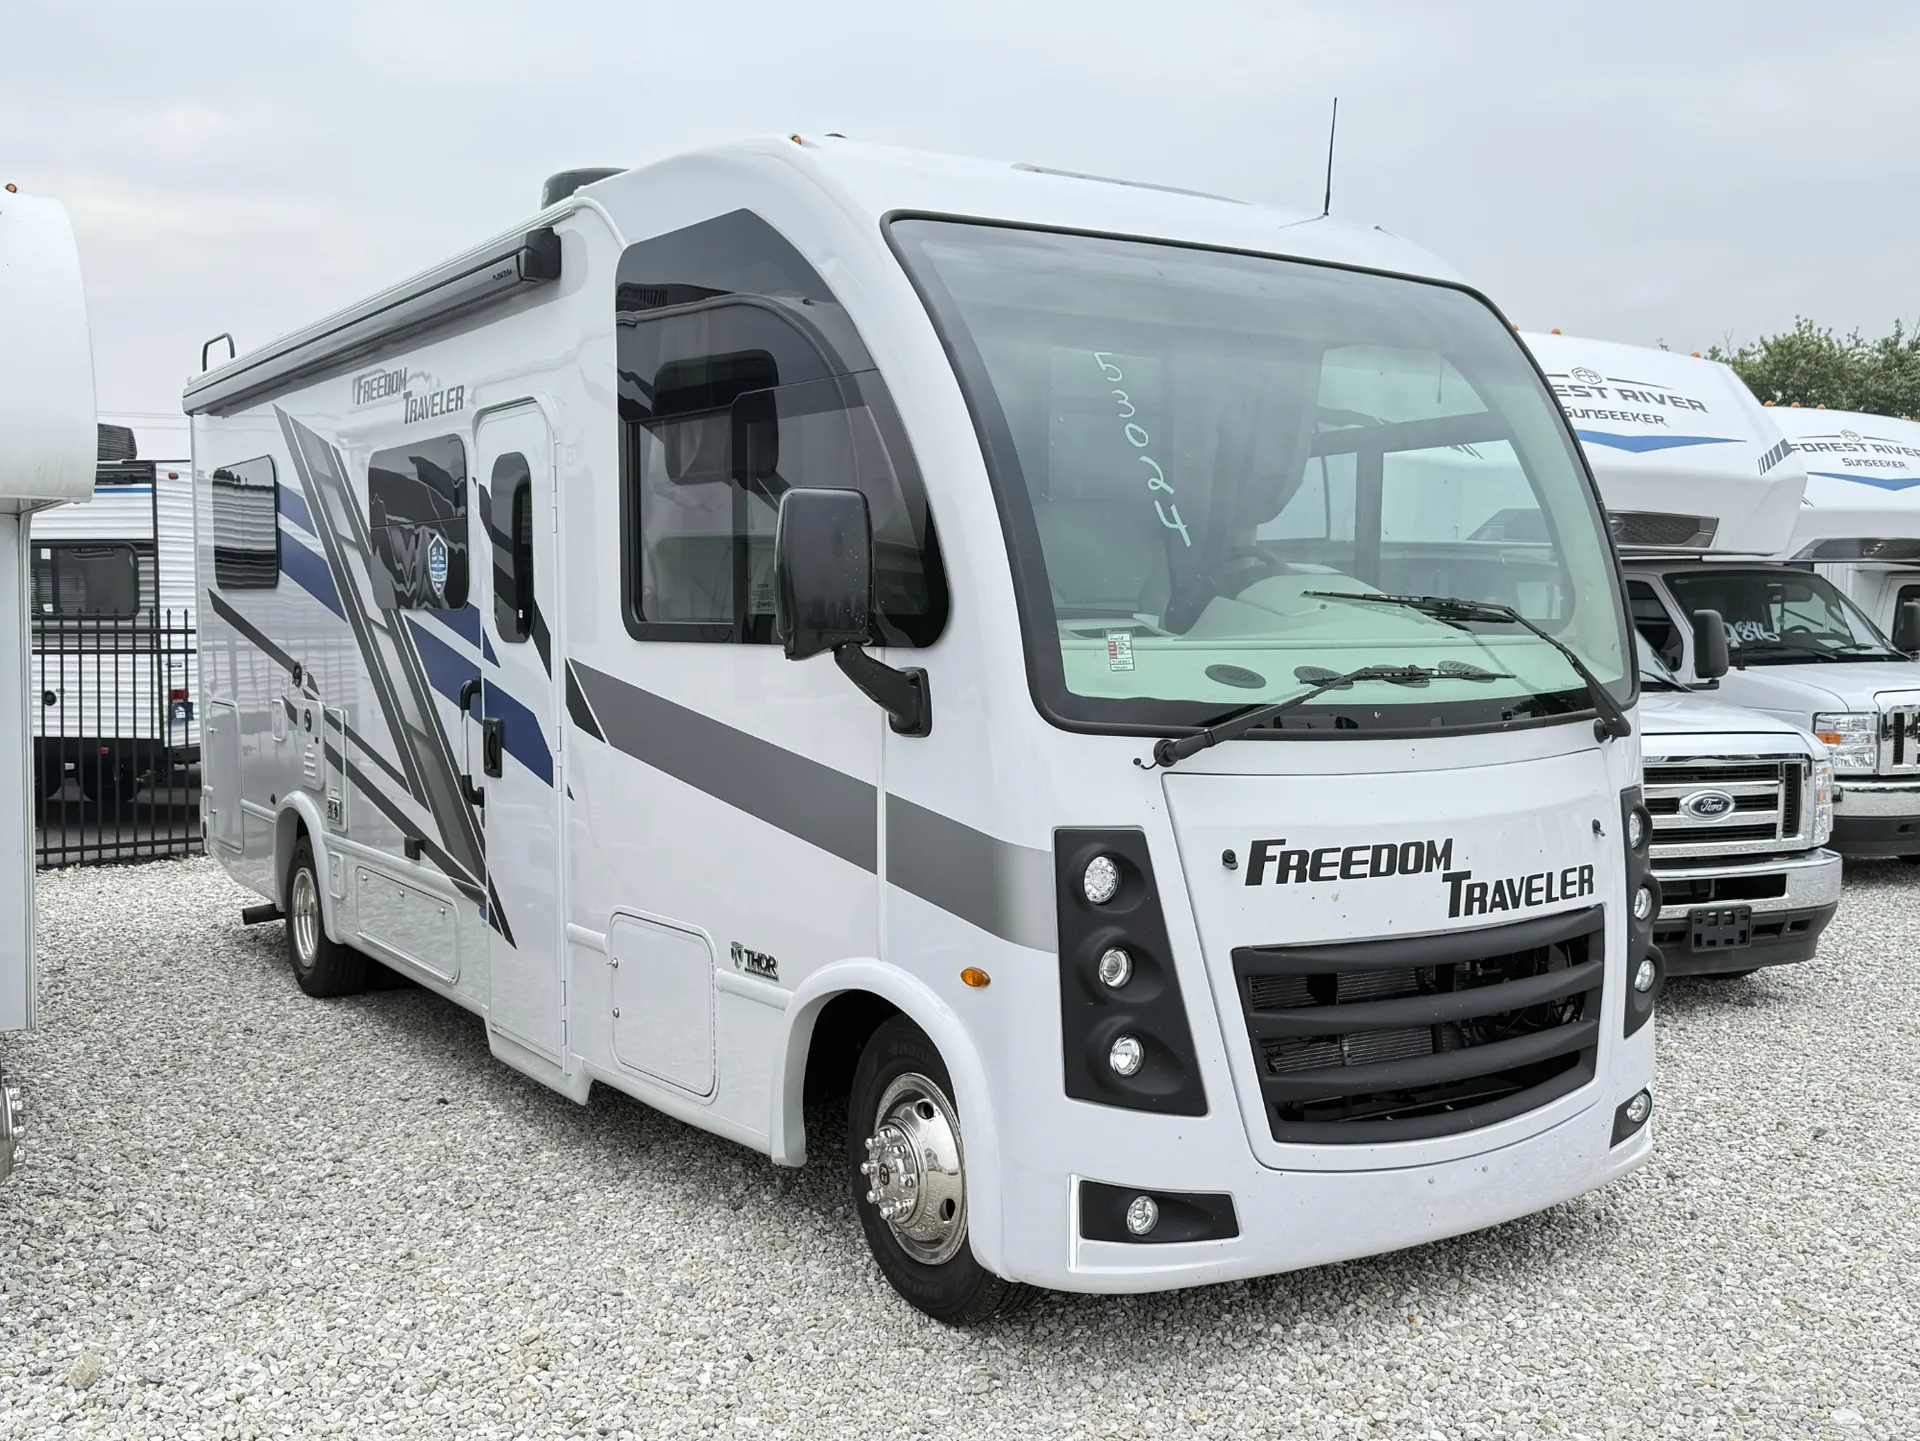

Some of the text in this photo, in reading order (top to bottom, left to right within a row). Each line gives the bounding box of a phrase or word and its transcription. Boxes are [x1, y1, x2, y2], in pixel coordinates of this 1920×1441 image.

[356, 367, 408, 405] FREEDOM
[403, 385, 465, 424] TRAVELER
[1551, 385, 1710, 413] EST RIVER
[1093, 352, 1191, 547] 53024
[1789, 443, 1868, 454] FOREST
[1700, 798, 1724, 812] Ford
[1245, 838, 1453, 886] FREEDOM
[1442, 864, 1595, 918] TRAVELER
[744, 948, 778, 976] THOR
